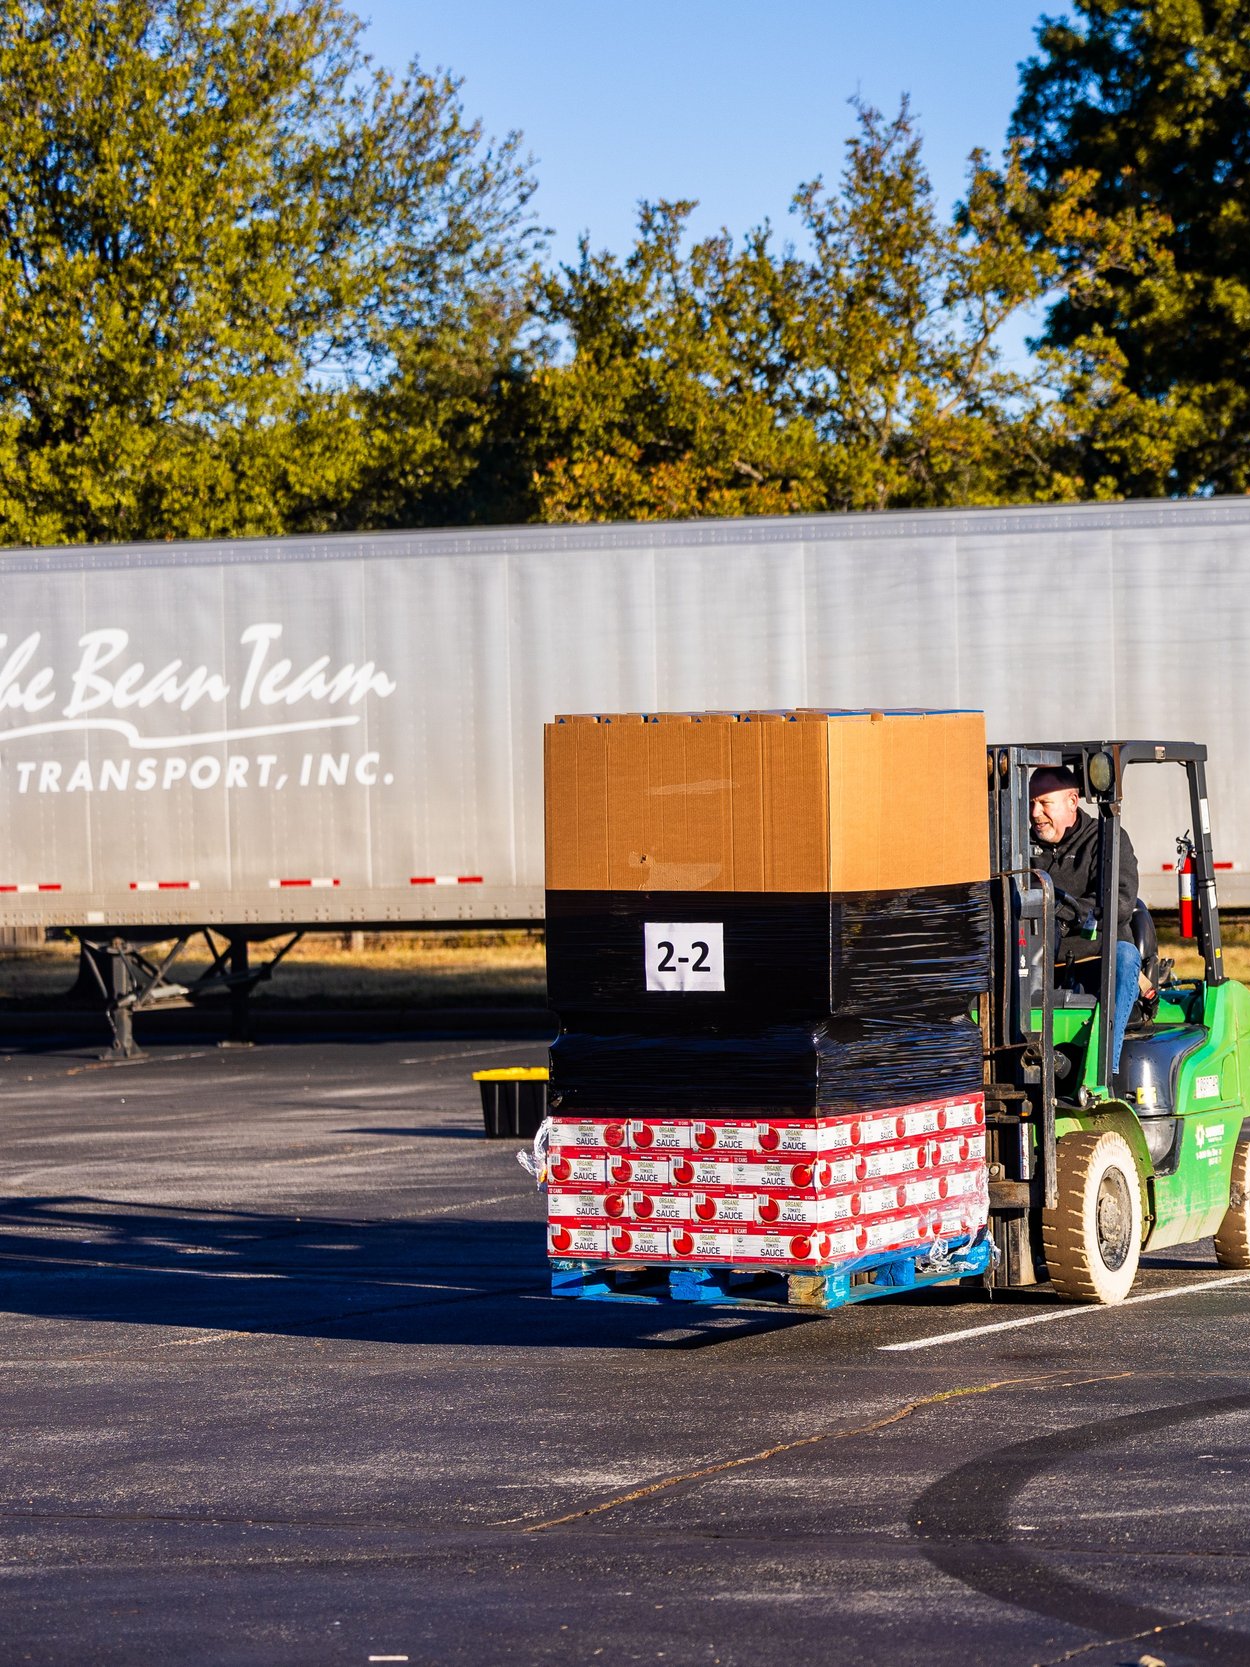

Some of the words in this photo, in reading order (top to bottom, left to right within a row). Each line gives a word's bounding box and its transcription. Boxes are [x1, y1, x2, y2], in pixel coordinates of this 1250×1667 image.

[0, 632, 56, 712] he
[62, 628, 230, 719] Bean
[240, 622, 397, 710] Team
[16, 754, 288, 794] TRANSPORT,
[300, 752, 394, 786] INC.
[657, 941, 711, 972] 2-2
[782, 1142, 806, 1150] SAUCE
[574, 1172, 597, 1180] SAUCE
[635, 1174, 658, 1182] SAUCE
[697, 1175, 720, 1183] SAUCE
[782, 1213, 806, 1221] SAUCE
